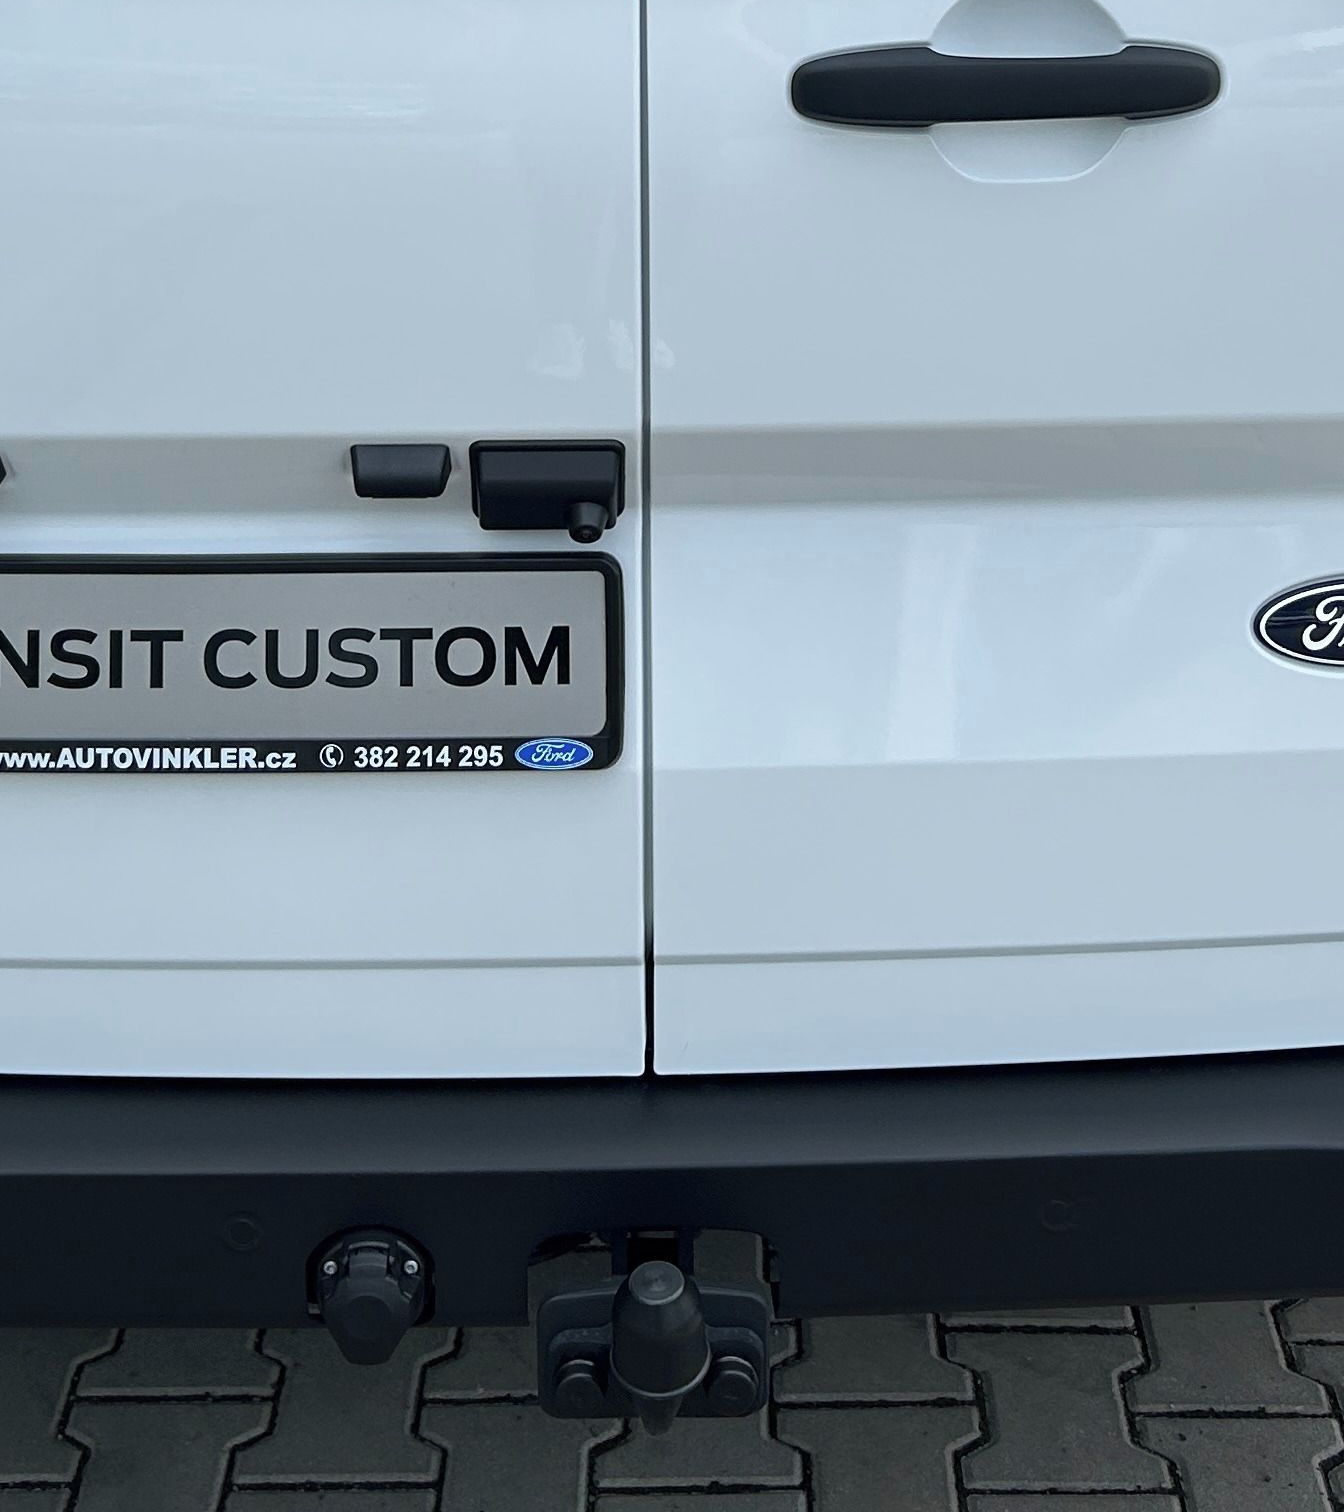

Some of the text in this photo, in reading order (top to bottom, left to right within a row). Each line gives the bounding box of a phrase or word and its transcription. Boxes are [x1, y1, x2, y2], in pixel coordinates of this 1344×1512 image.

[203, 625, 570, 688] CUSTOM
[354, 746, 398, 768] 382
[406, 746, 451, 768] 214
[459, 745, 503, 768] 295
[531, 743, 577, 763] Ford
